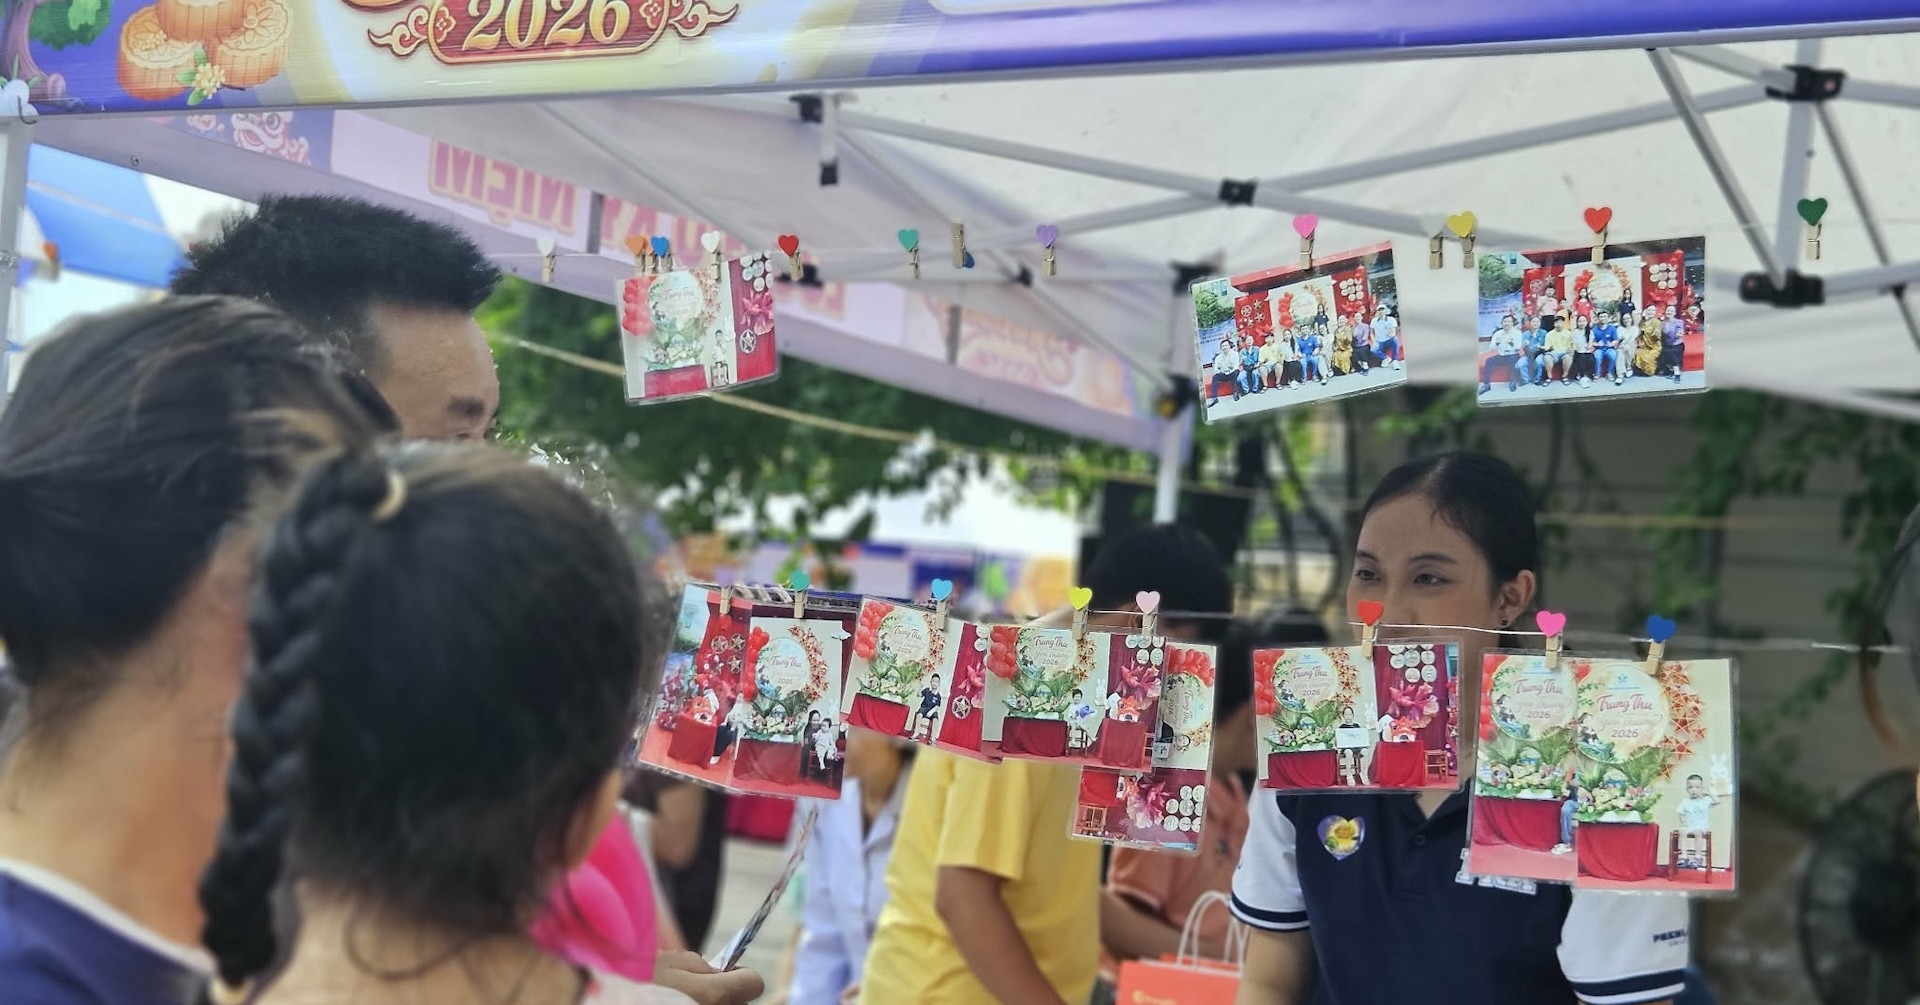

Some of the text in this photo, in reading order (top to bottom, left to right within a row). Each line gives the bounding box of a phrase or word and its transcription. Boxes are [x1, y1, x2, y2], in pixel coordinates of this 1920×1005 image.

[462, 0, 630, 52] 2026
[1033, 635, 1068, 648] Trung Thu
[1291, 666, 1328, 679] Trung Thu
[1514, 678, 1563, 696] Trung Thu
[1596, 693, 1653, 713] Trung Thu
[1527, 711, 1551, 719] 2026
[1611, 729, 1639, 738] 2026
